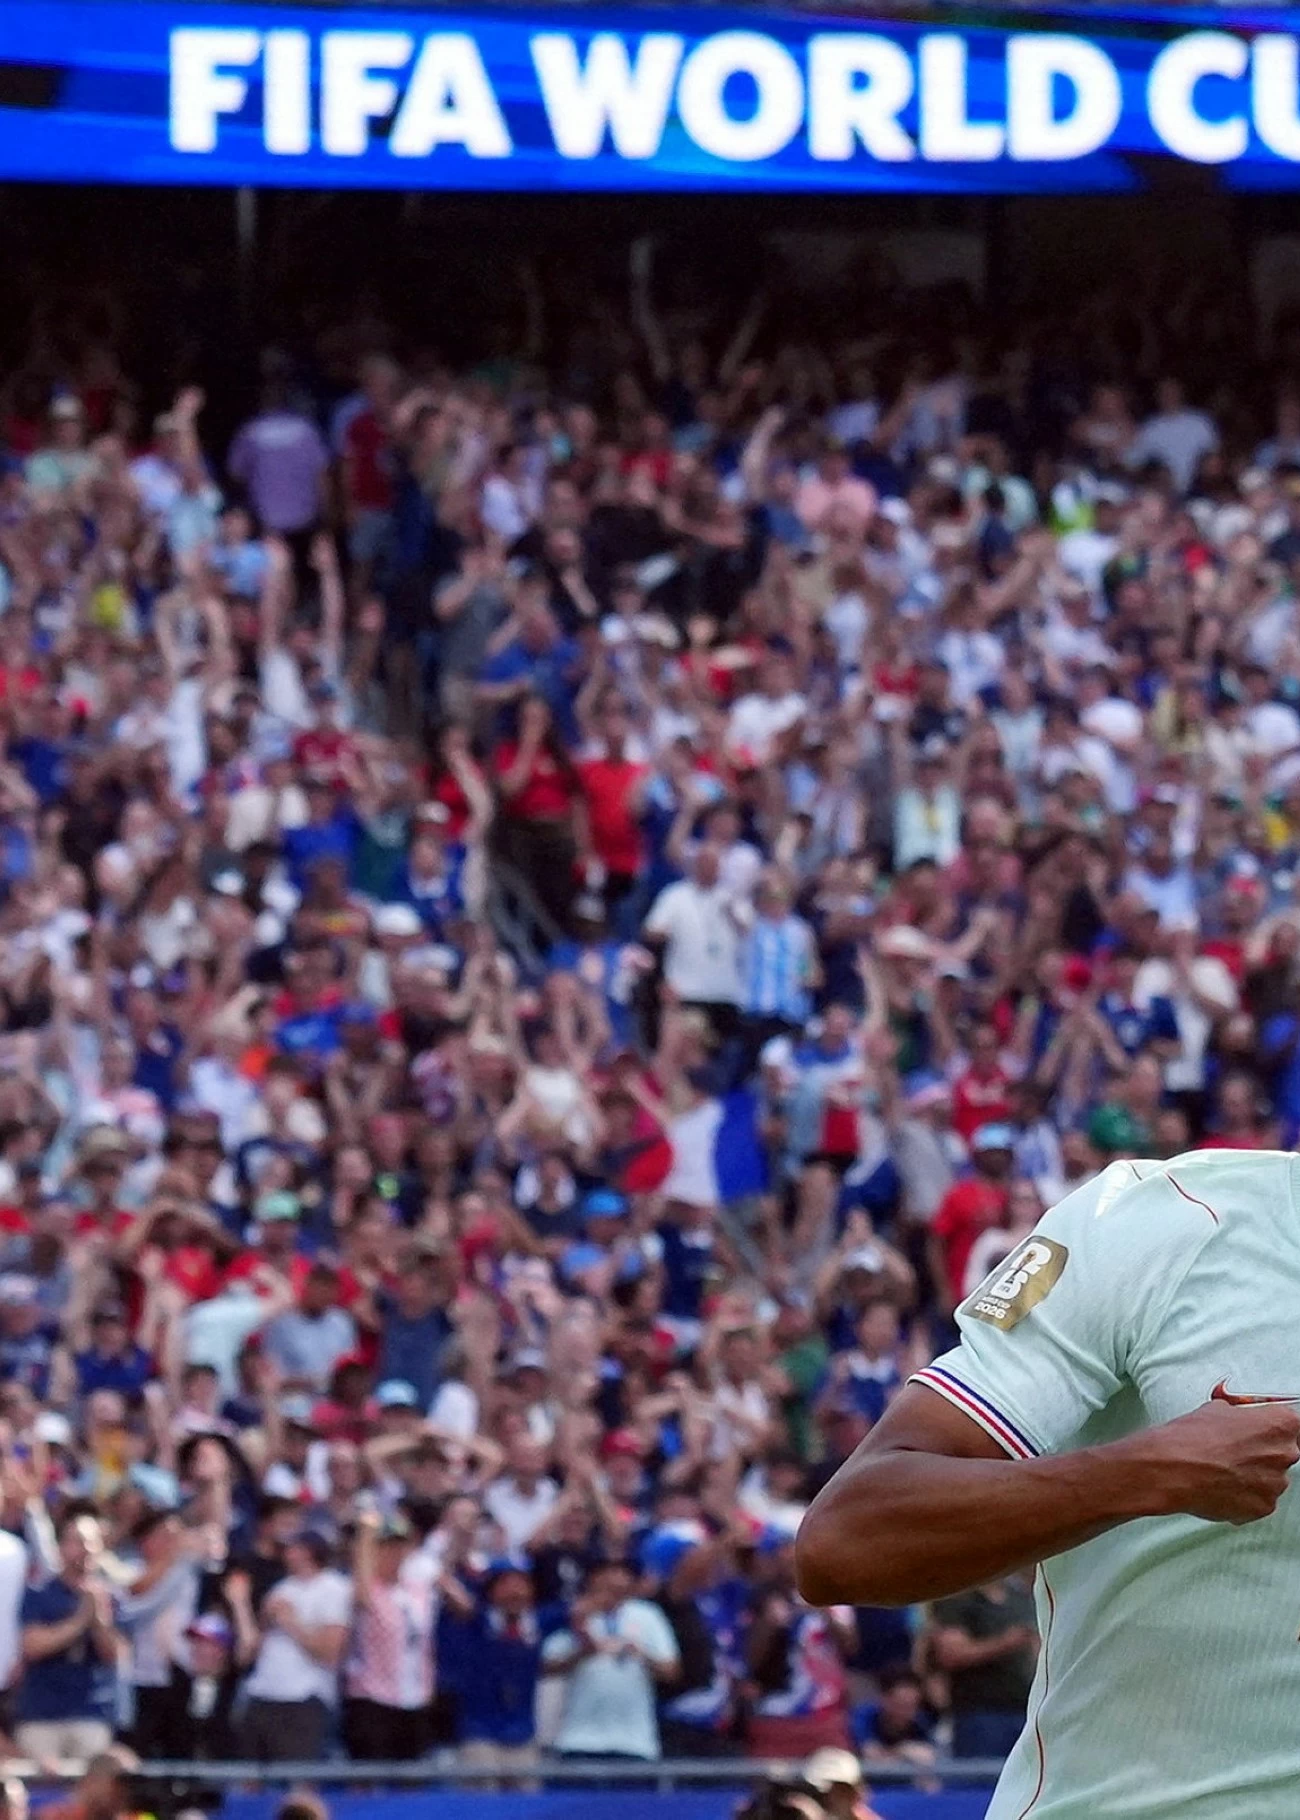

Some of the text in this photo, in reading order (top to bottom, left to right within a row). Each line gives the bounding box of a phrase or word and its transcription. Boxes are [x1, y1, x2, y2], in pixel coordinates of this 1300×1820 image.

[170, 29, 511, 158] FIFA
[531, 34, 1121, 162] WORLD
[975, 1302, 1007, 1319] 2026
